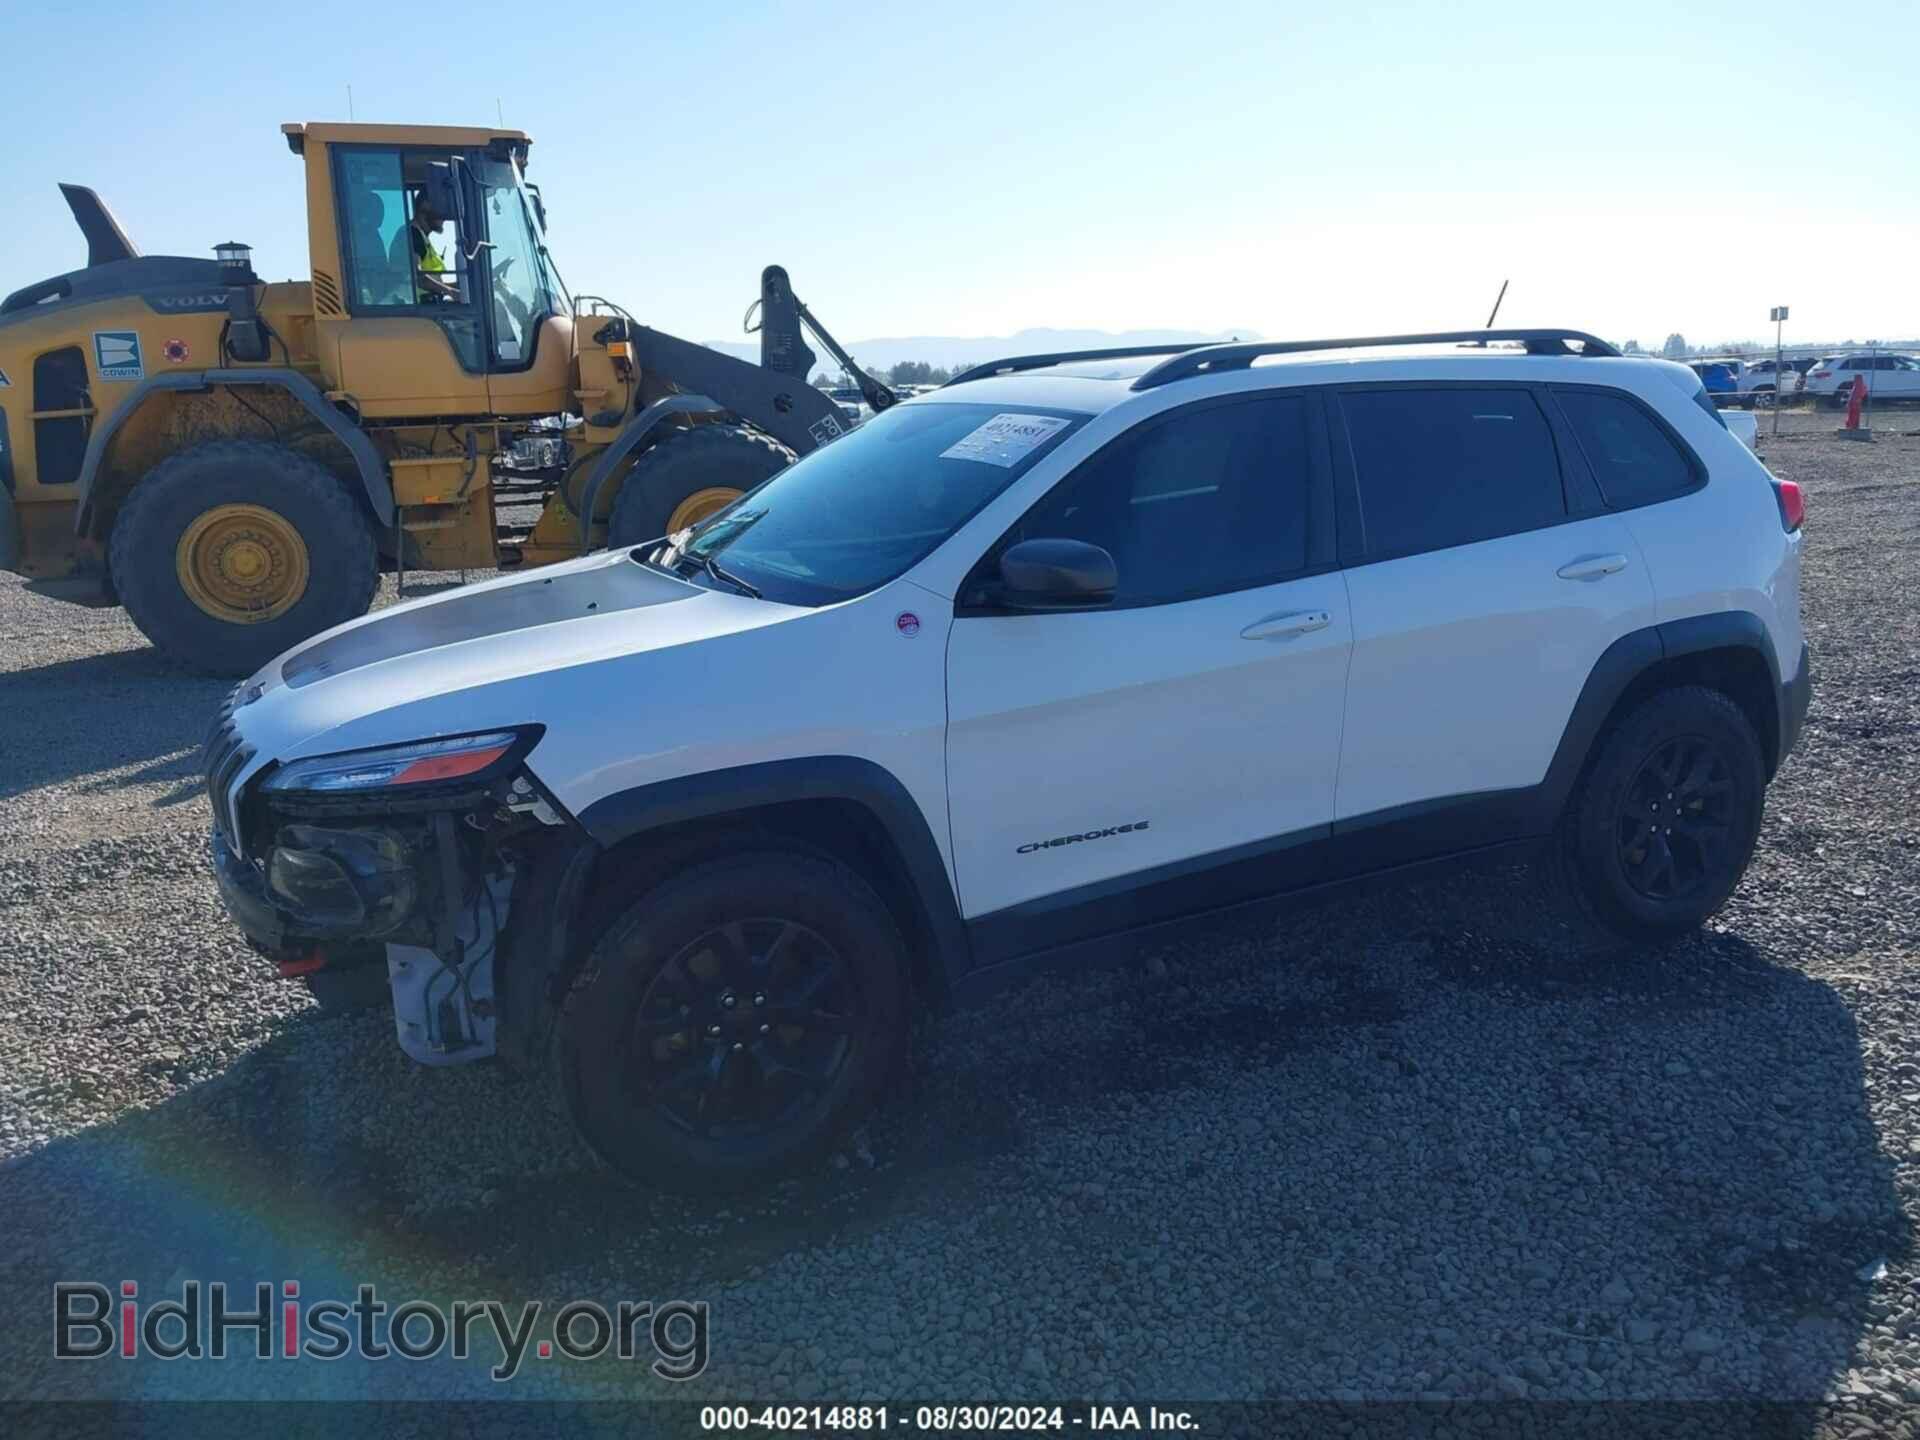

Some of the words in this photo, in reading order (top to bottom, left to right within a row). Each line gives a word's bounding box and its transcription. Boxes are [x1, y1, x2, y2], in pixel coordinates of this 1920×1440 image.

[160, 295, 231, 307] VOLV
[102, 368, 140, 377] COWIN
[1016, 821, 1149, 854] CHEROKEE
